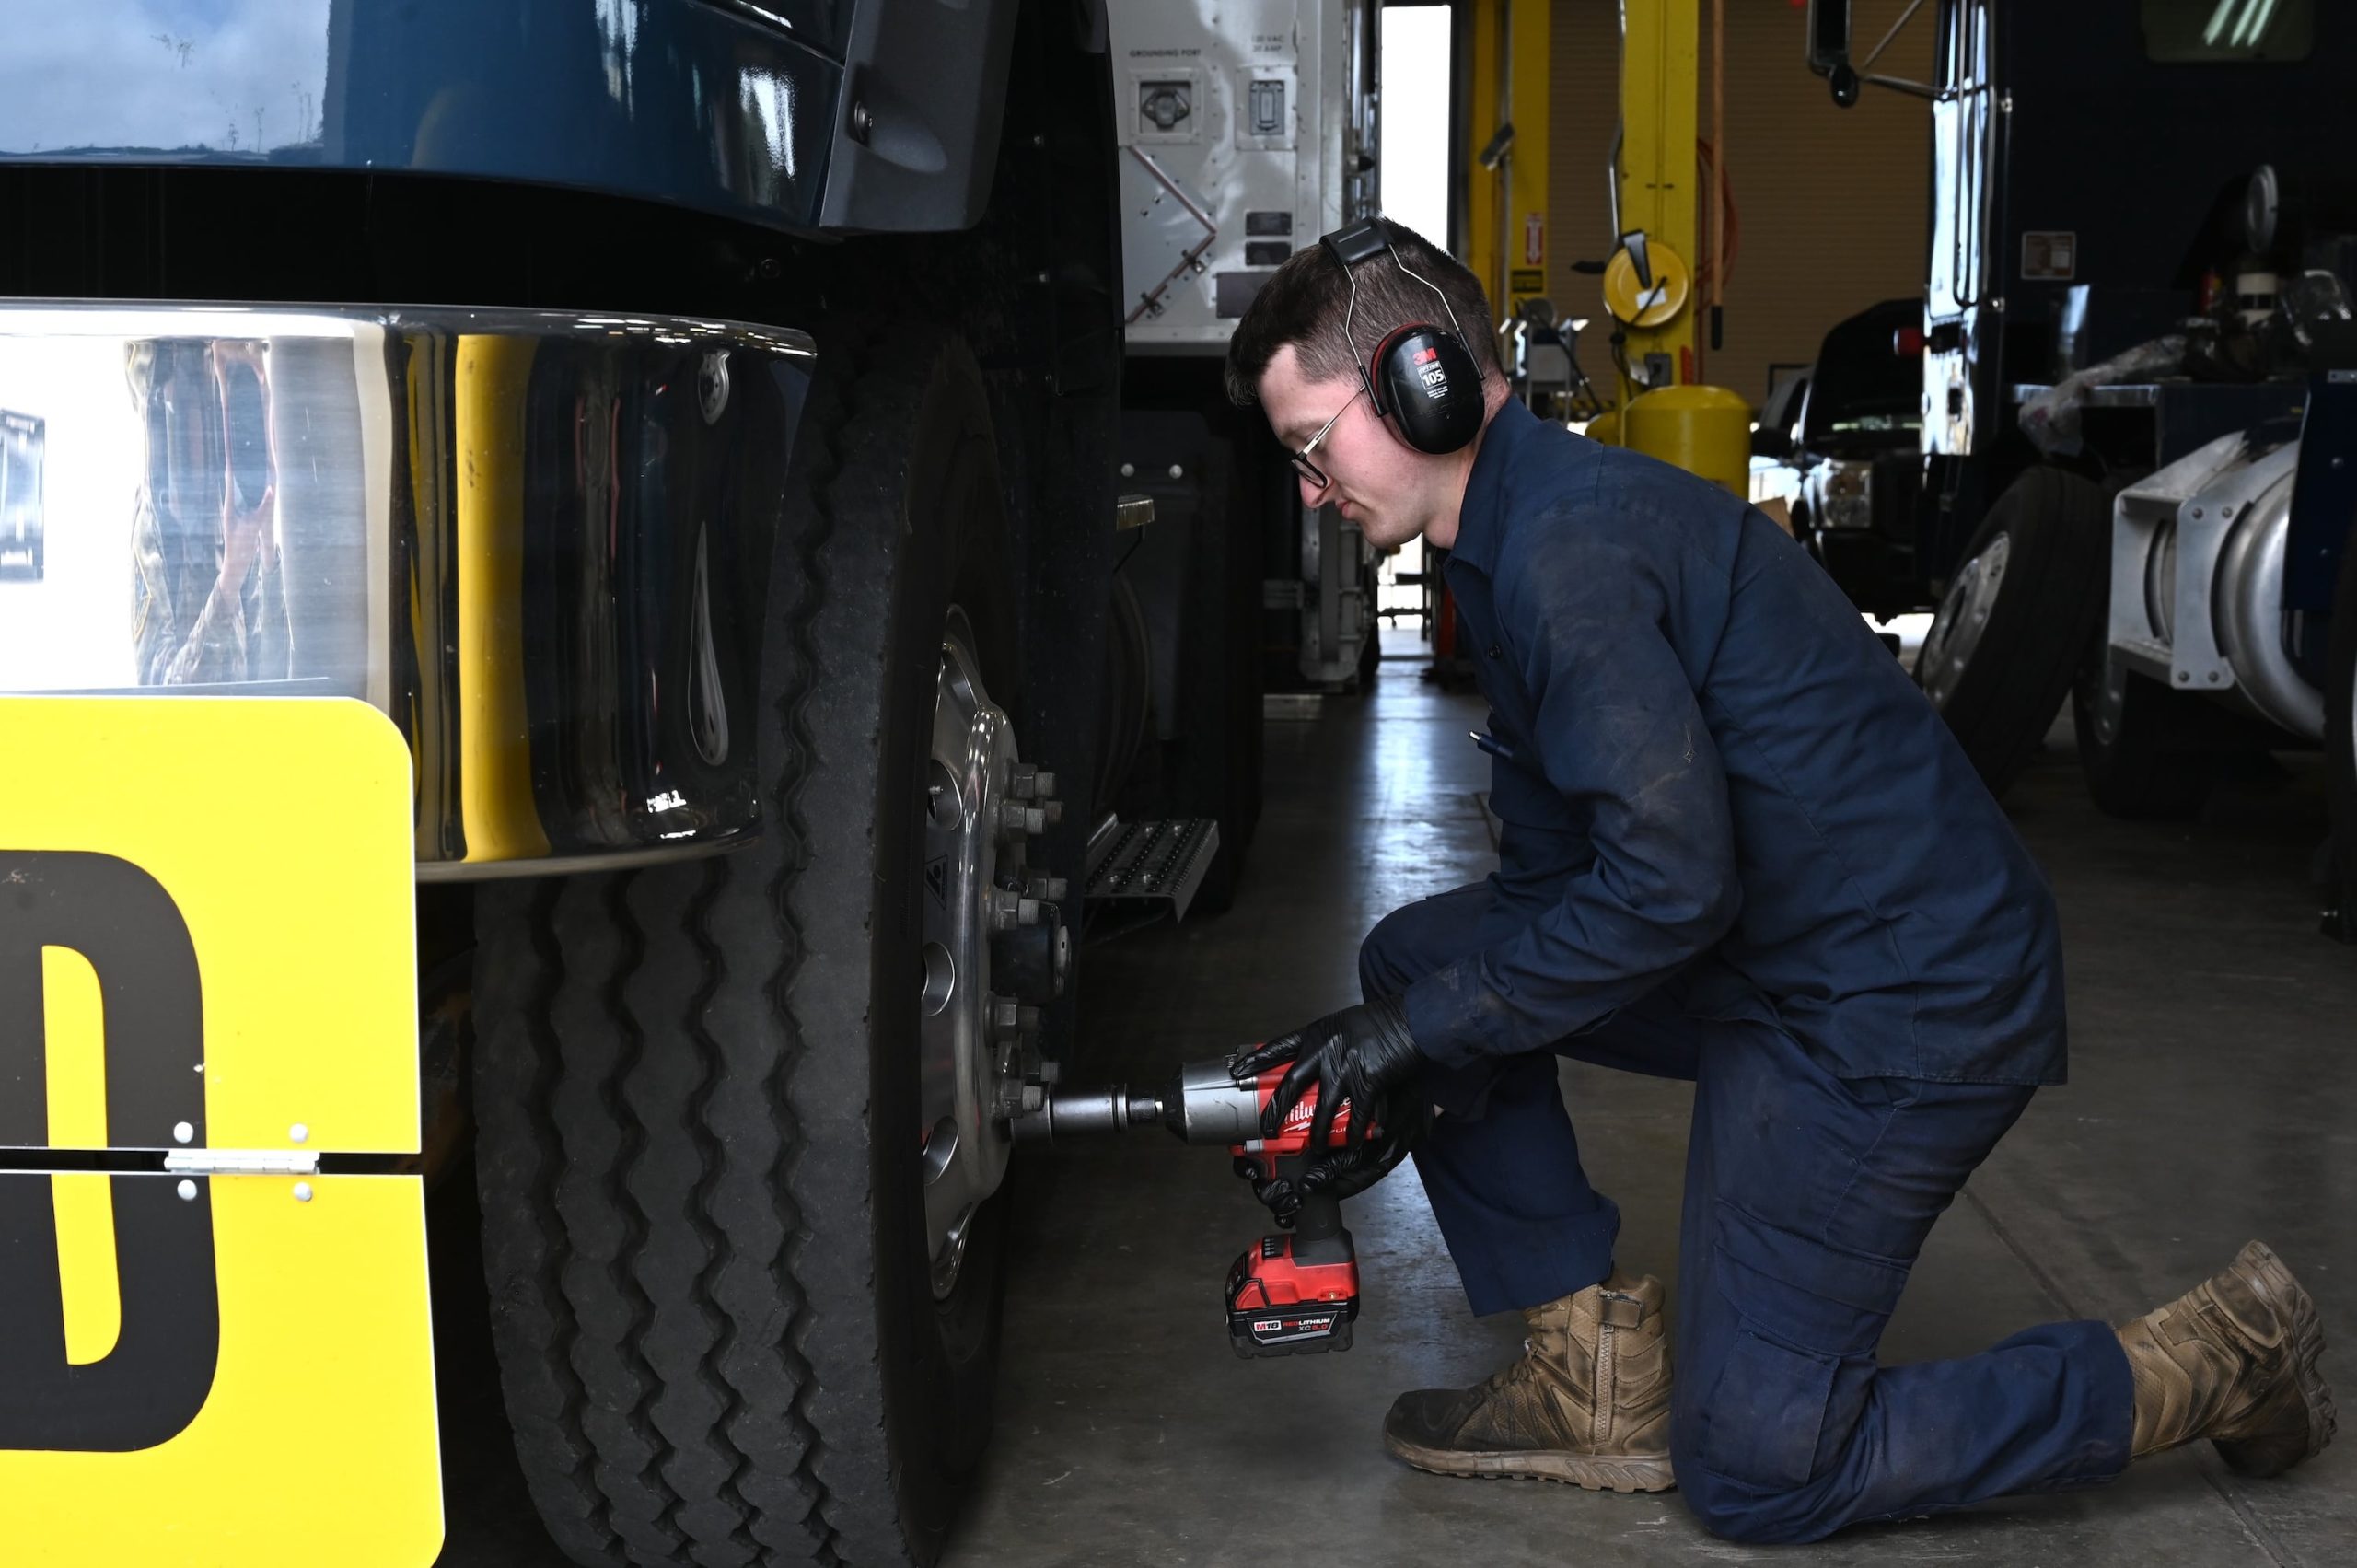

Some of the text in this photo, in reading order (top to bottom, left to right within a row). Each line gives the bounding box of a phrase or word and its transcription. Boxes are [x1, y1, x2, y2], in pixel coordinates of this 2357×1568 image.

[1267, 34, 1284, 42] VAC
[1129, 48, 1201, 58] GROUNDING PORT
[1412, 347, 1437, 366] 3M
[1422, 369, 1445, 386] 105
[1255, 1321, 1280, 1331] M18
